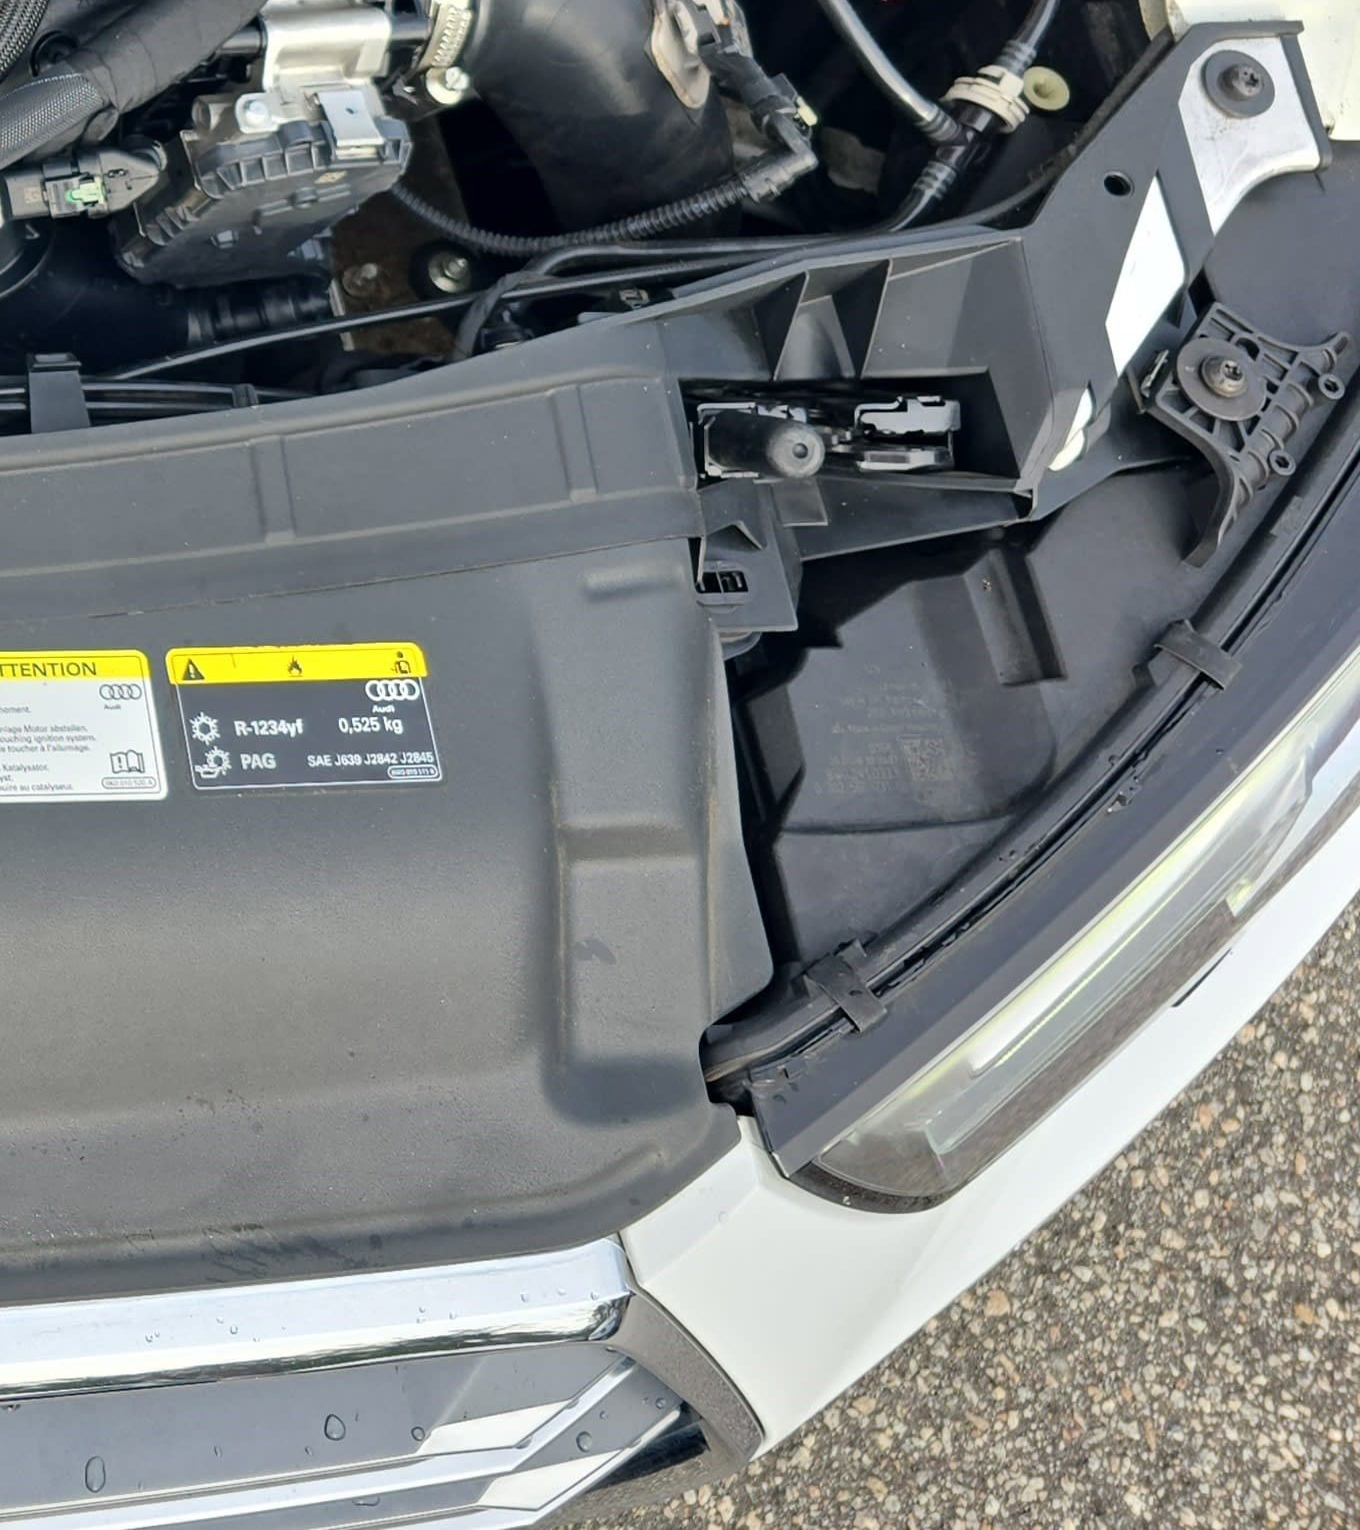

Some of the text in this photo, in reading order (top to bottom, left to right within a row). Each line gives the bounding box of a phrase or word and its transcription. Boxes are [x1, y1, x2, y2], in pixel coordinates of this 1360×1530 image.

[372, 704, 395, 713] Audi
[23, 724, 47, 733] Motor
[234, 716, 403, 738] R-1234yf 0,525 kg
[34, 734, 64, 743] ignition
[7, 745, 38, 753] toucher
[240, 752, 434, 770] PAG SAE J639 J2842 J2845
